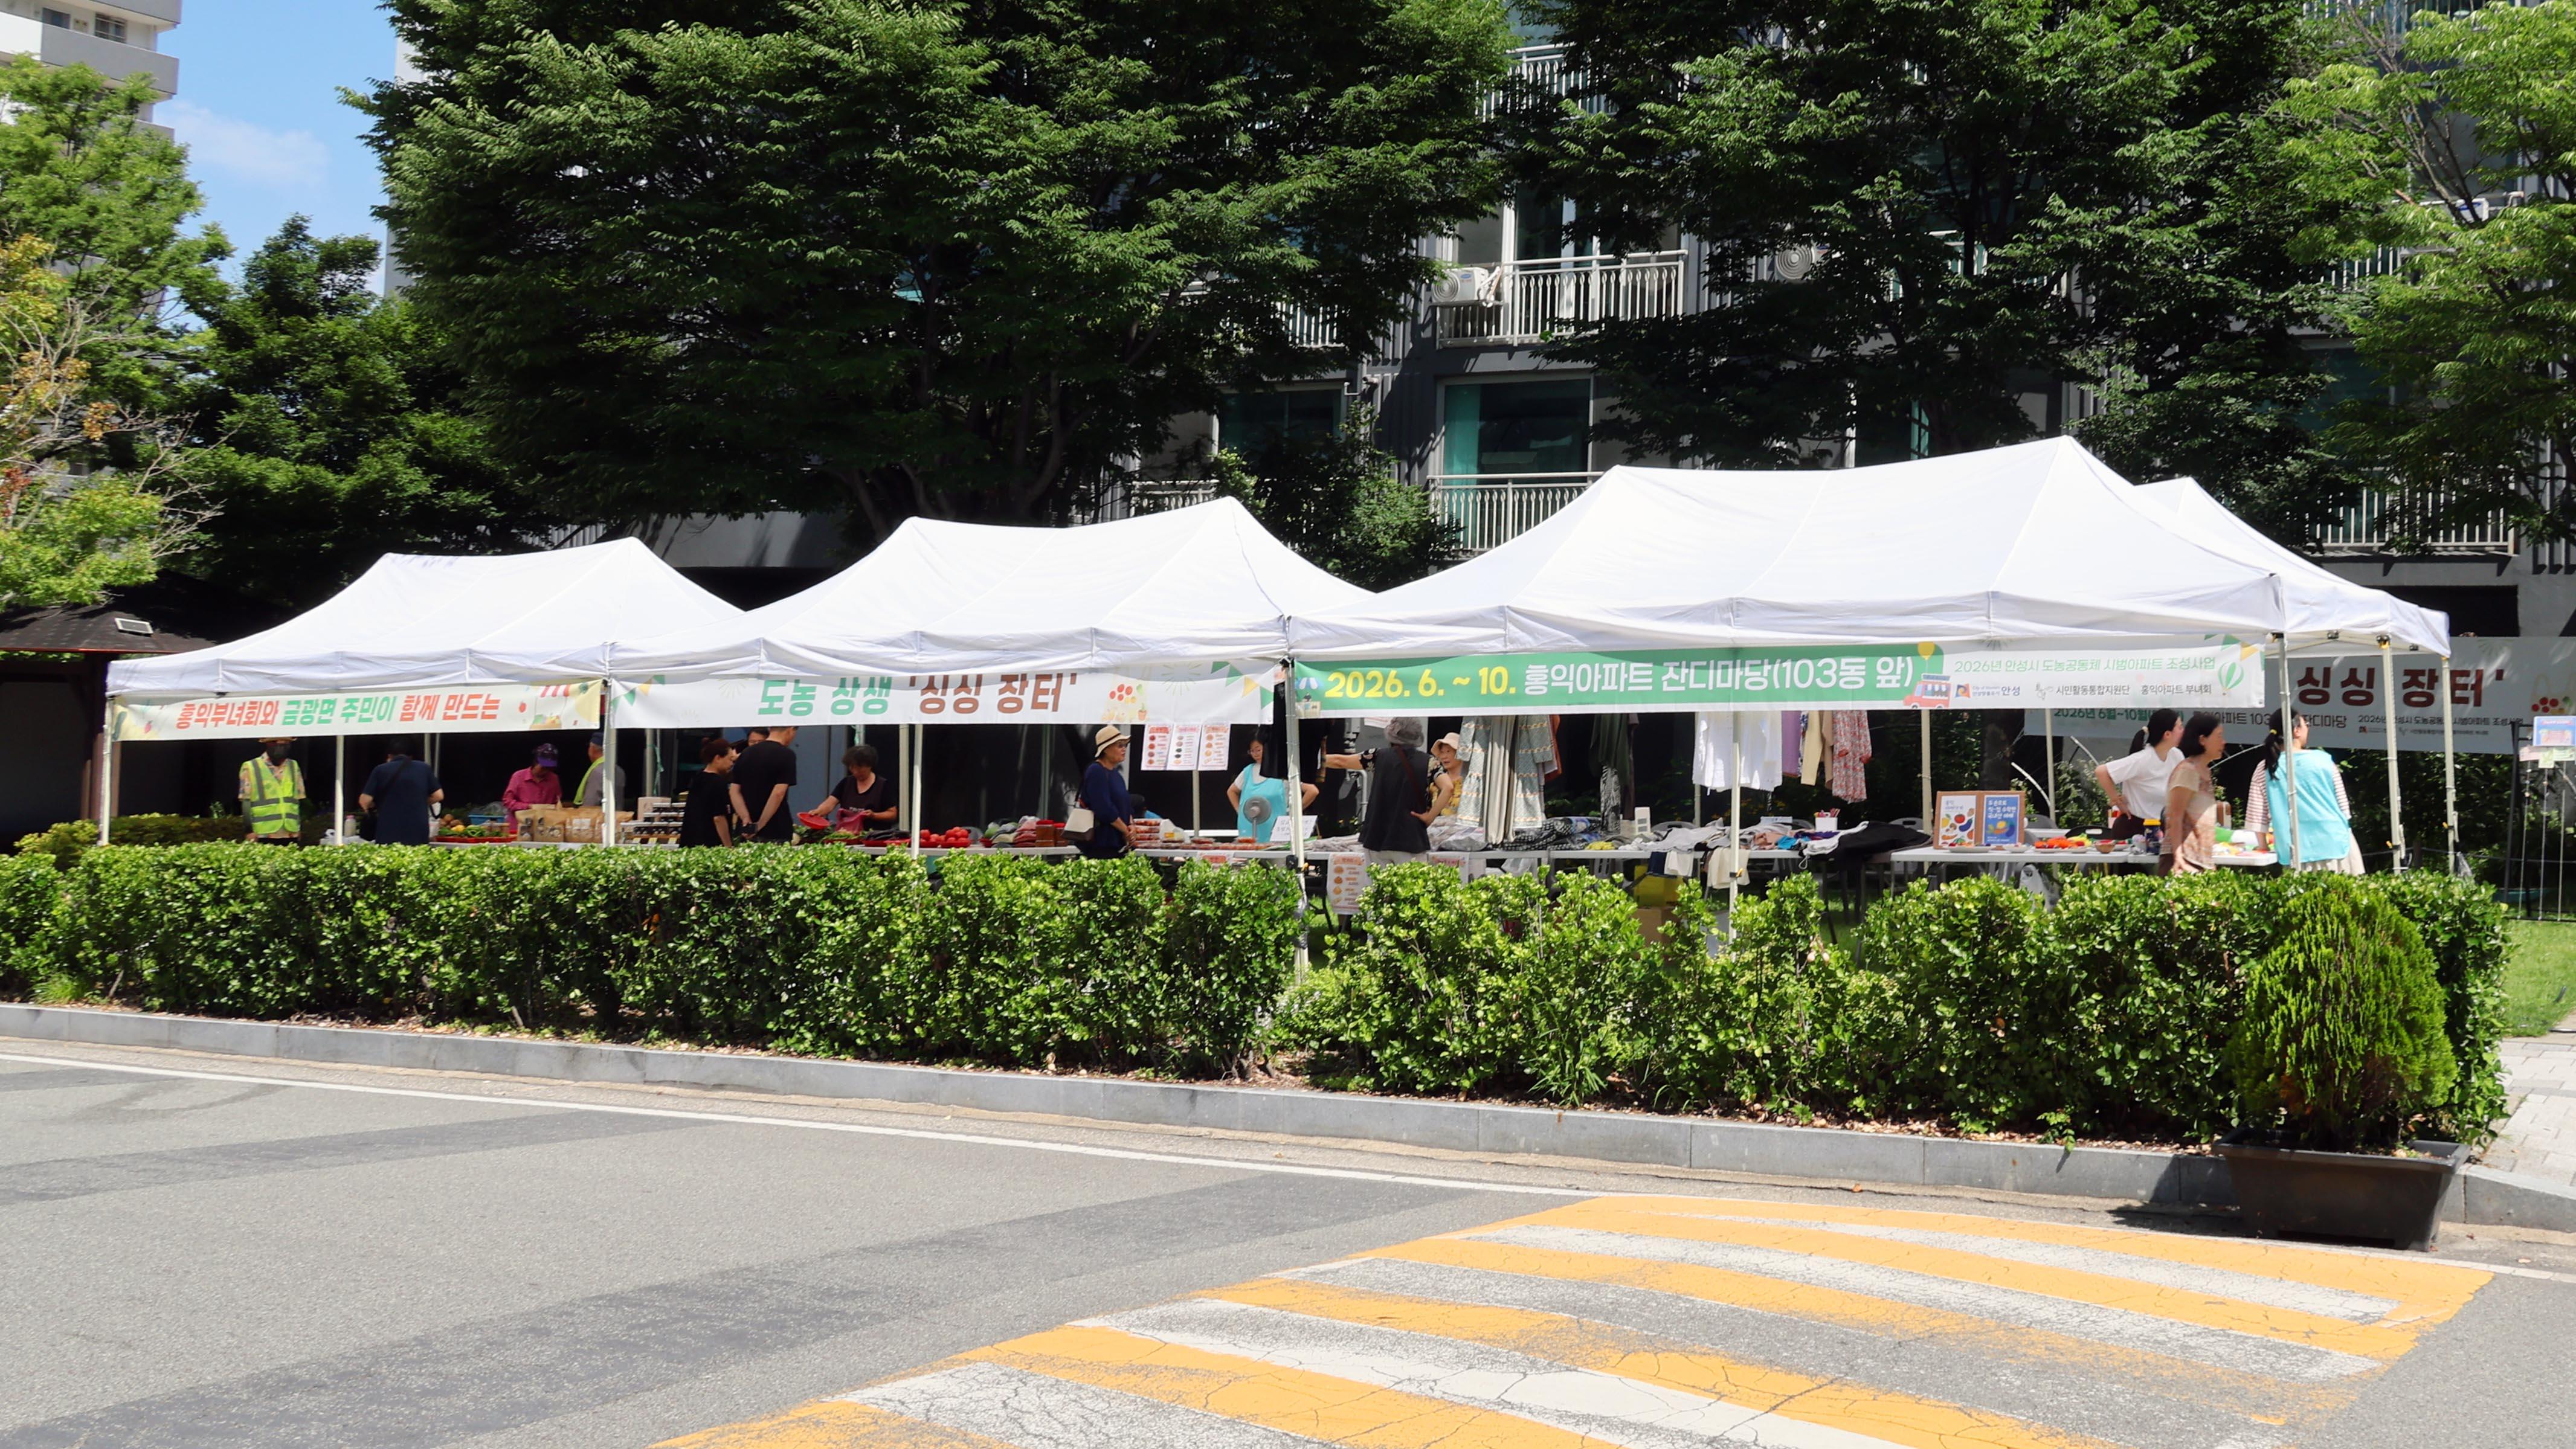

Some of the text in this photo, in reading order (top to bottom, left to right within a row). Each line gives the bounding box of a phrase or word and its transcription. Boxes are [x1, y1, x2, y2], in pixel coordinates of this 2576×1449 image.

[1954, 657, 2215, 672] 2026년 안성시 도농공동체 시범아파트 조성사업
[1324, 668, 1410, 698] 2026.
[1418, 669, 1444, 696] 6.
[1478, 666, 1516, 695] 10.
[1524, 663, 1653, 695] 홍익아파트
[1661, 657, 1866, 692] 잔디마당(103동
[1876, 656, 1913, 688] 앞)
[758, 672, 1077, 716] 도농 상생 '싱싱 장터'
[2001, 685, 2021, 696] 안성
[2056, 685, 2130, 696] 시민활동통합지원단
[2141, 684, 2212, 695] 홍익아파트 부녀회
[2297, 667, 2375, 707] 싱싱
[176, 693, 501, 730] 홍익부녀회와 금광면 주민이 함께 만드는
[2194, 712, 2247, 724] 아파트
[2250, 713, 2272, 725] 103
